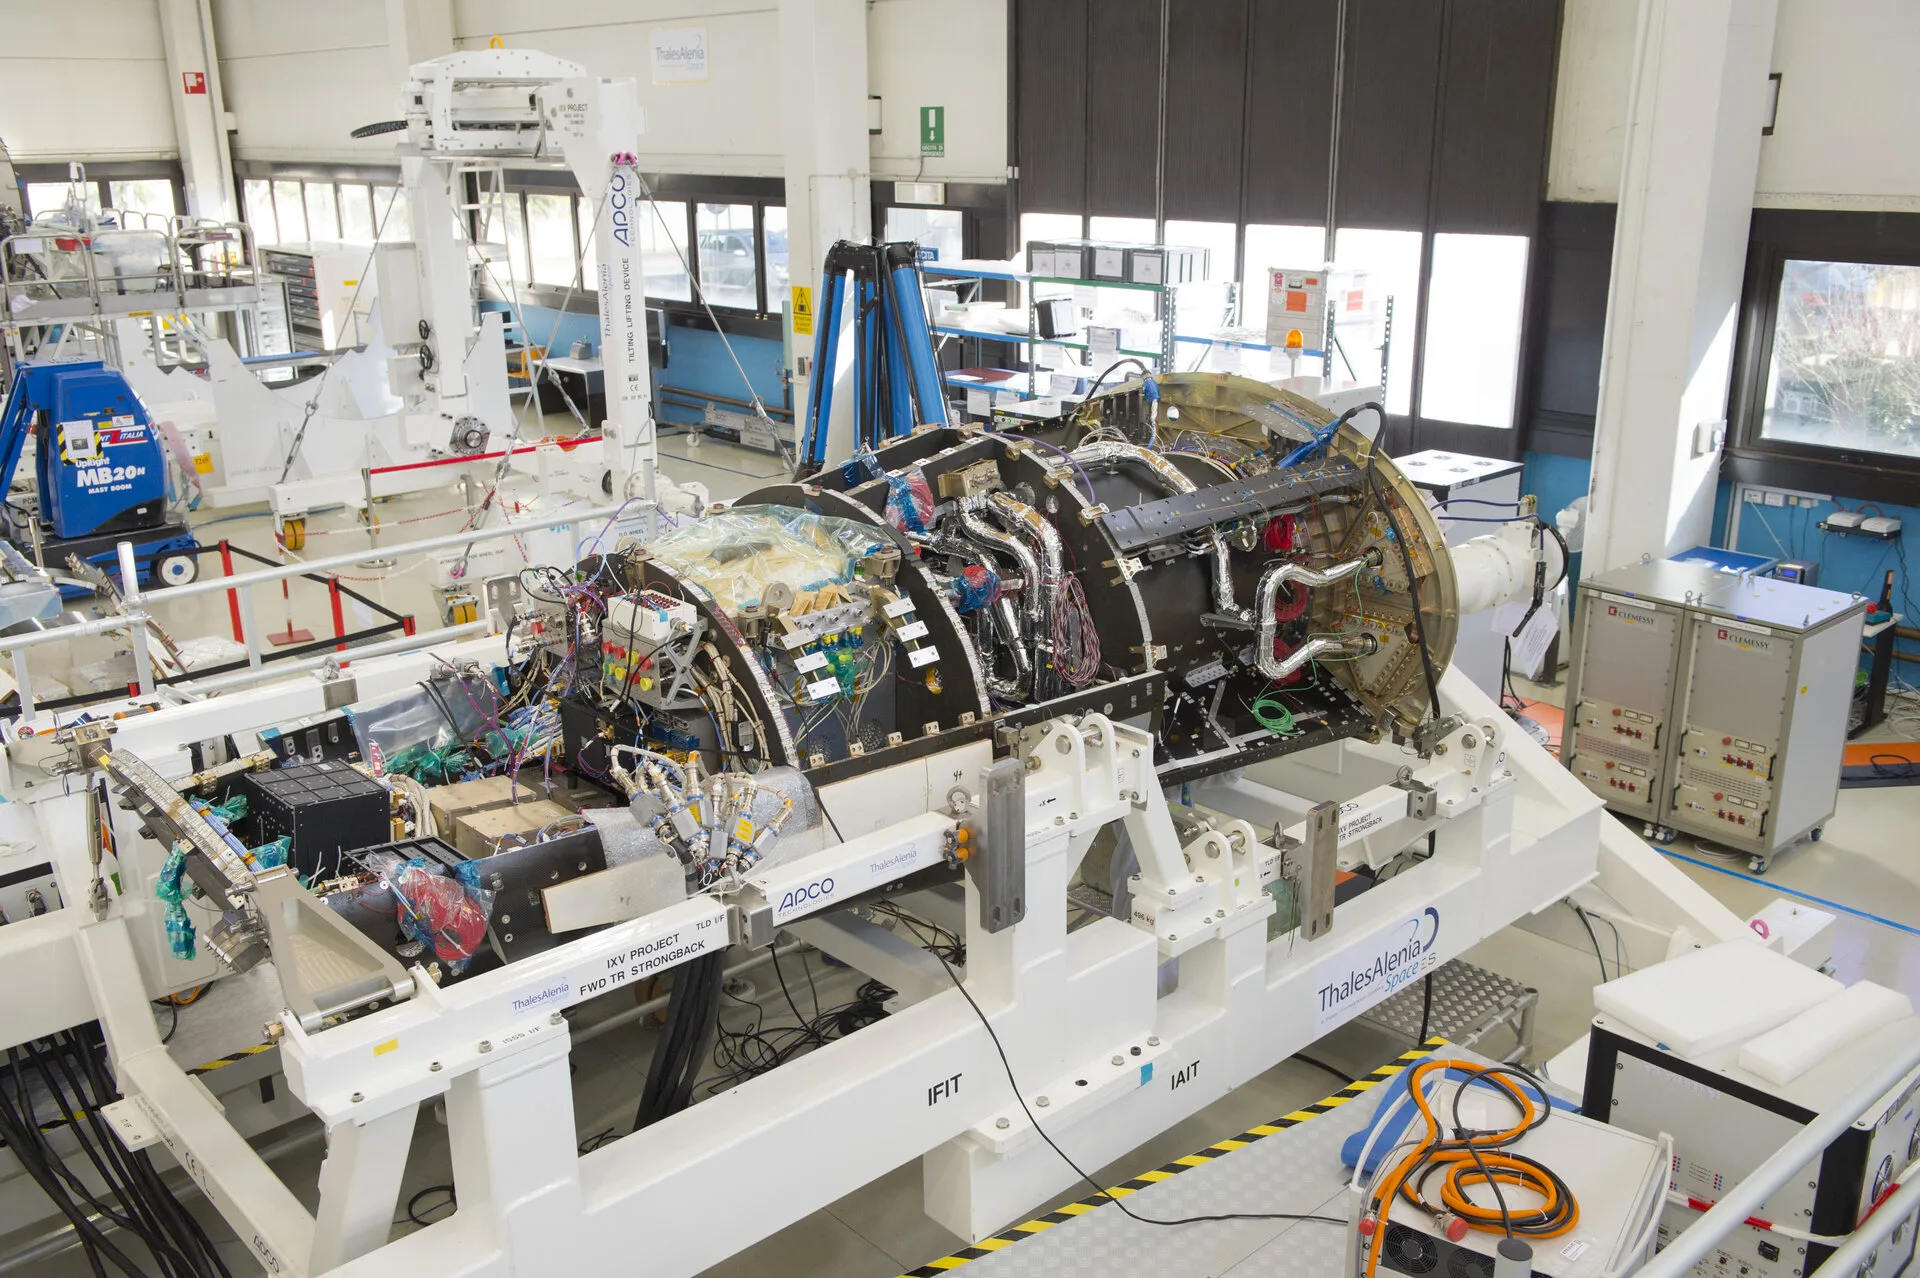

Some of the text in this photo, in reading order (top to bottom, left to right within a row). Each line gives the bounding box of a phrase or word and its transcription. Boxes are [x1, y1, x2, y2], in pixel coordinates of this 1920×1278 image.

[611, 174, 630, 247] APCO
[622, 258, 635, 364] TILTING LIFTING DEVICE
[119, 431, 144, 440] ITALIA
[75, 458, 110, 468] UpRight
[22, 497, 38, 505] PCM
[88, 483, 132, 495] MAST BOOM
[1618, 611, 1656, 625] CLEMESSY
[1728, 634, 1770, 650] CLEMESSY
[1348, 813, 1371, 829] PROJECT
[1348, 816, 1383, 838] STRONGBACK
[869, 850, 917, 874] ThalesAlenia
[778, 877, 834, 913] APCO
[778, 893, 835, 918] TECHNOLOGIES
[695, 914, 725, 930] TLD I/F
[1133, 911, 1155, 926] 496 kg
[607, 933, 680, 969] IXV PROJECT
[579, 940, 705, 996] FWD TR STRONGBACK
[1318, 939, 1421, 1012] ThalesAlenia
[1384, 961, 1419, 993] Space
[512, 983, 569, 1011] ThalesAlenia
[1171, 1060, 1200, 1091] IAIT
[928, 1074, 963, 1107] IFIT
